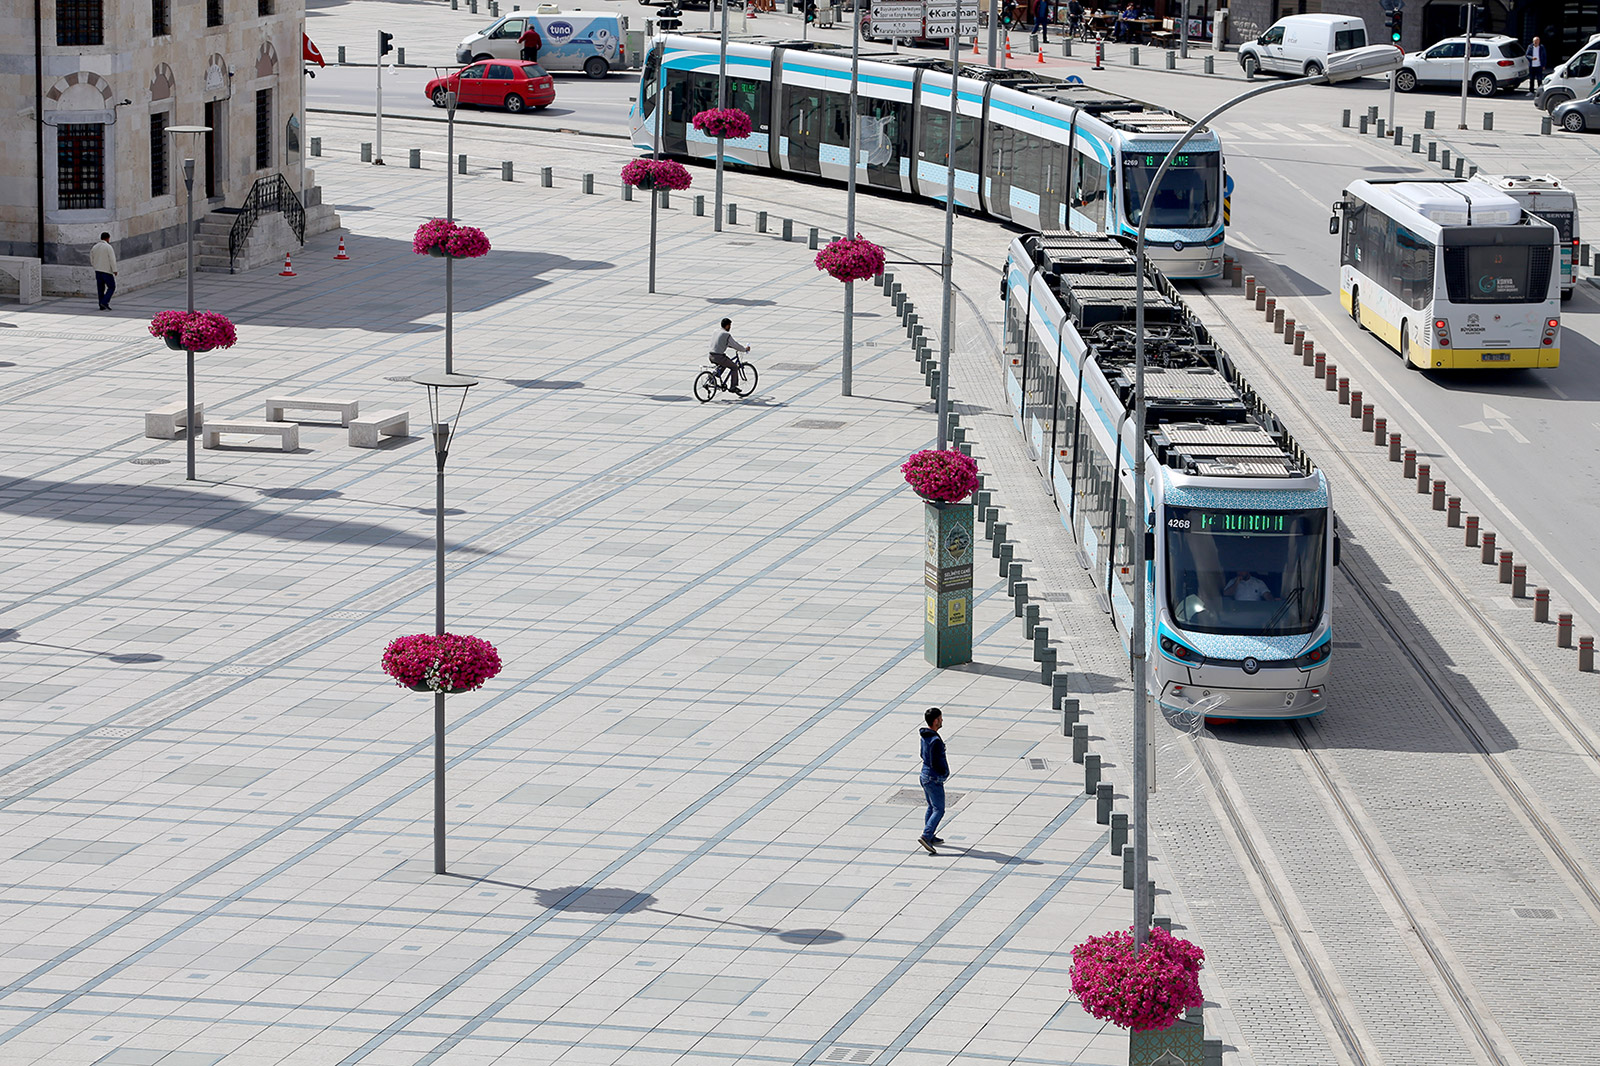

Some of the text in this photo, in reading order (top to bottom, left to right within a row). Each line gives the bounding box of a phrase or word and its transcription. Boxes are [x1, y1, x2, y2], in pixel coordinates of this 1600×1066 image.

[935, 9, 977, 17] Karaman
[550, 26, 570, 34] tuna
[935, 25, 977, 35] Antlya
[1168, 519, 1190, 529] 4268
